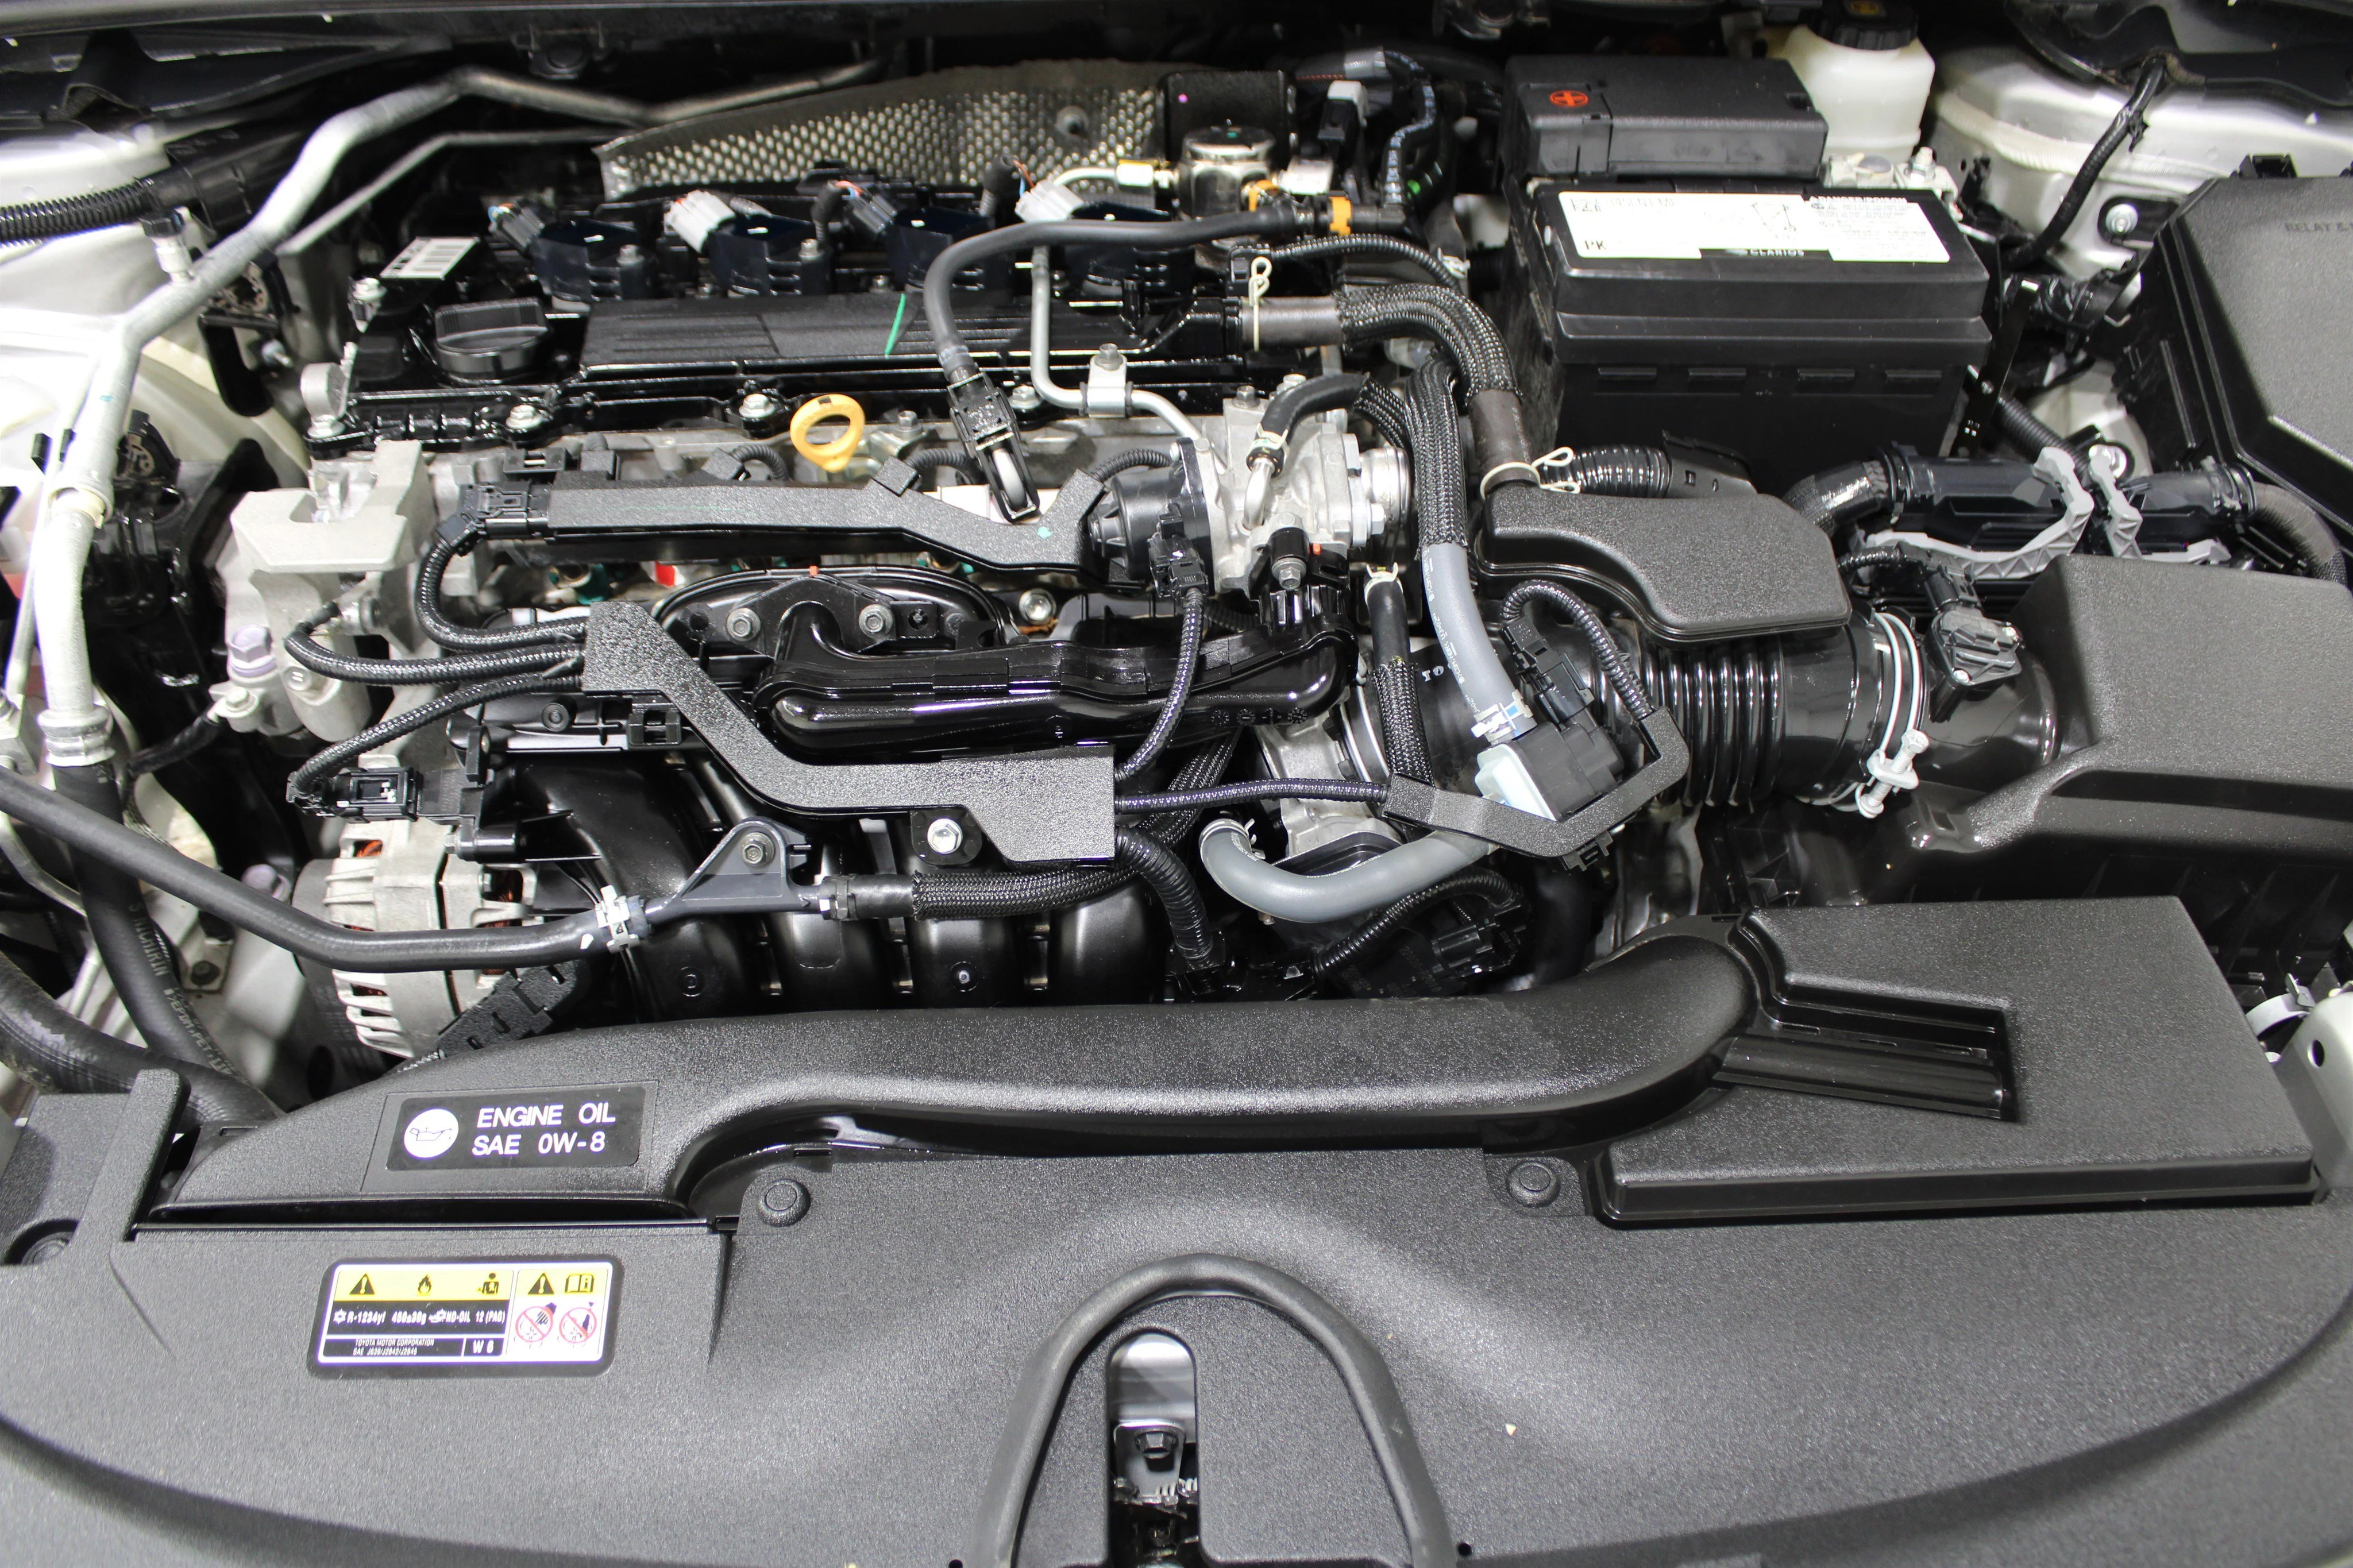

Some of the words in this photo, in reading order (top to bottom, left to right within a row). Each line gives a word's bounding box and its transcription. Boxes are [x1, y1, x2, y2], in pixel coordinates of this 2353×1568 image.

[477, 1104, 564, 1127] ENGINE
[578, 1102, 616, 1124] OIL
[472, 1134, 522, 1156] SAE
[538, 1130, 606, 1154] 0W-8
[476, 1310, 484, 1323] 12
[356, 1338, 376, 1346] TOYOTA
[376, 1338, 396, 1346] MOTOR
[396, 1338, 435, 1346] CORPORATION
[473, 1339, 484, 1354] W
